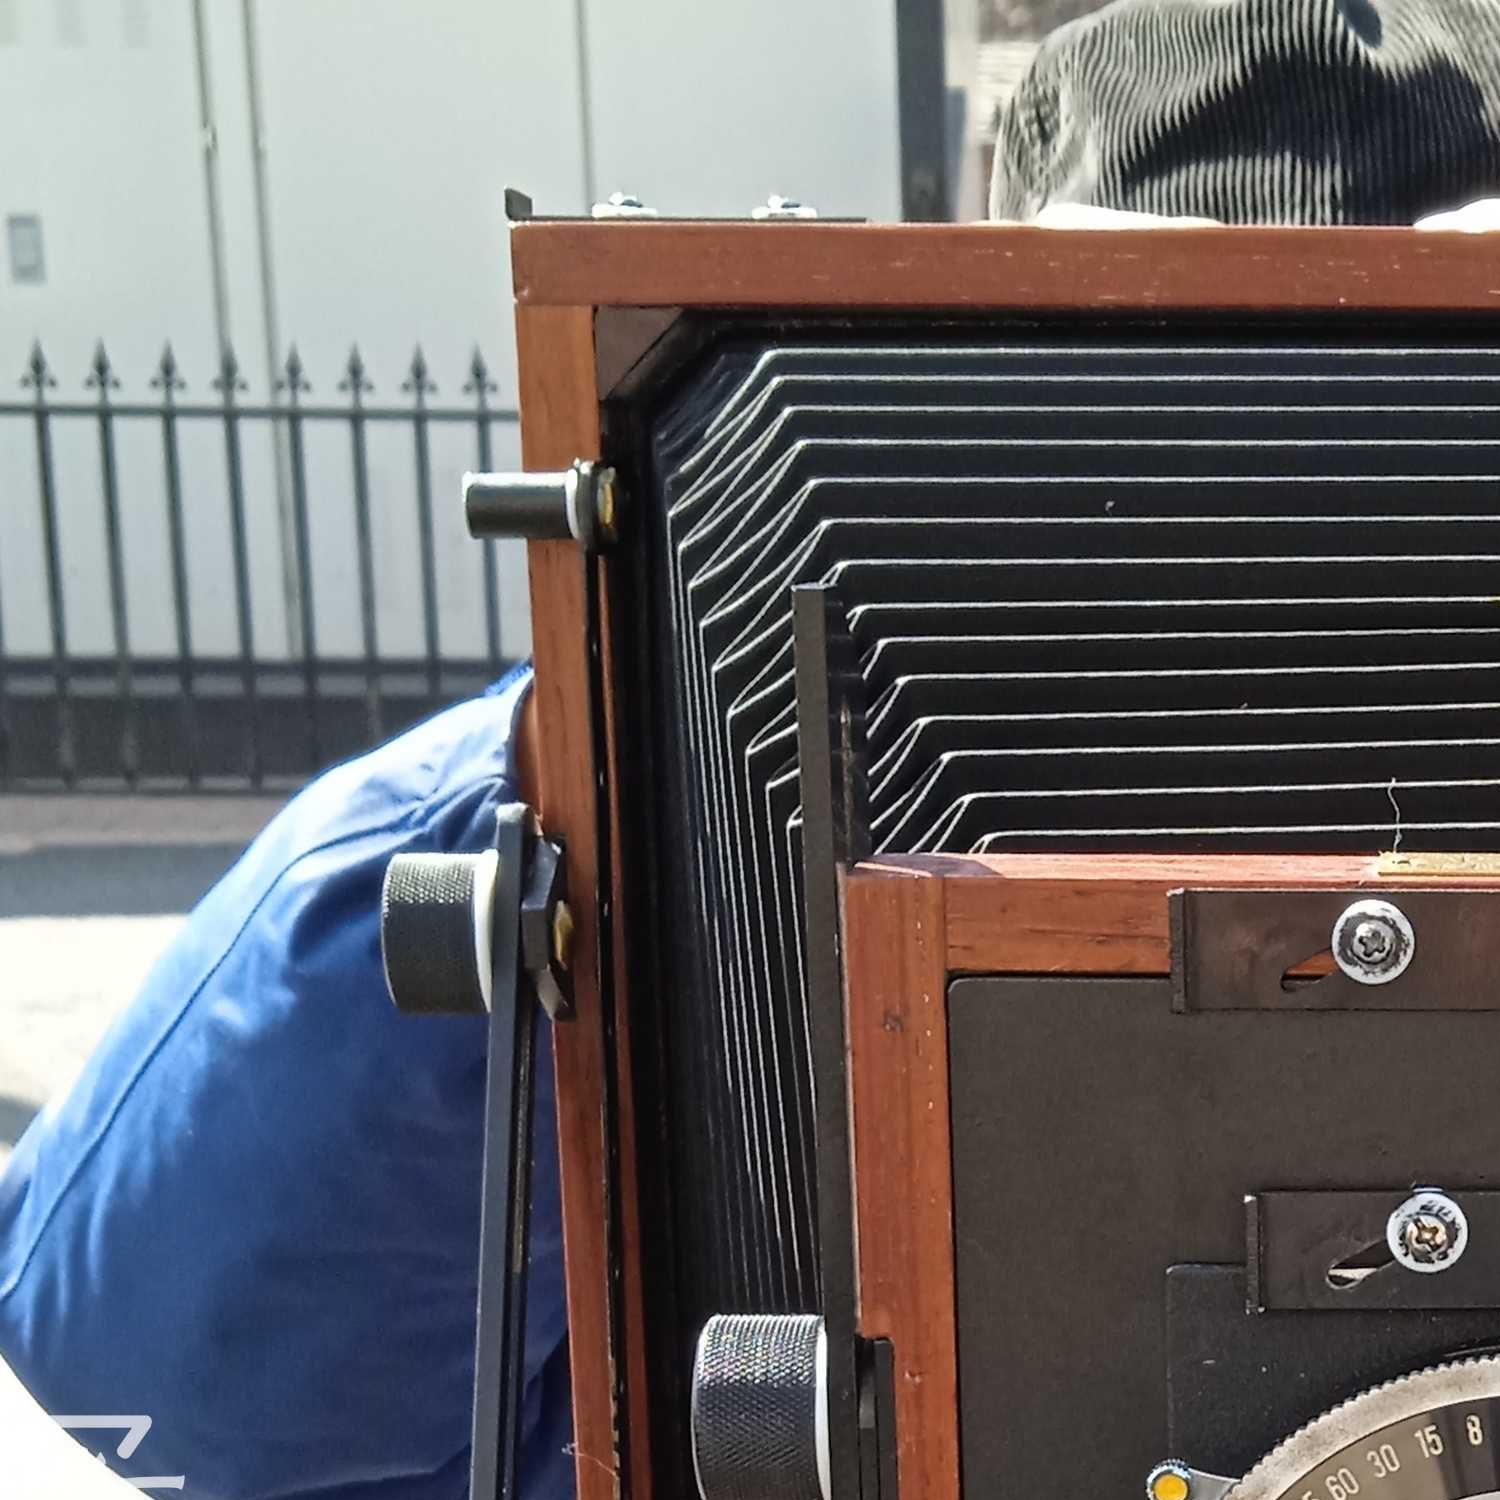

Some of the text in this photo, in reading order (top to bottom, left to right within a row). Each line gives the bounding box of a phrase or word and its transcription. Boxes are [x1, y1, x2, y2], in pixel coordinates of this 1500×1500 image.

[1366, 1443, 1401, 1479] 30
[1414, 1424, 1444, 1458] 15
[1466, 1414, 1484, 1446] 8
